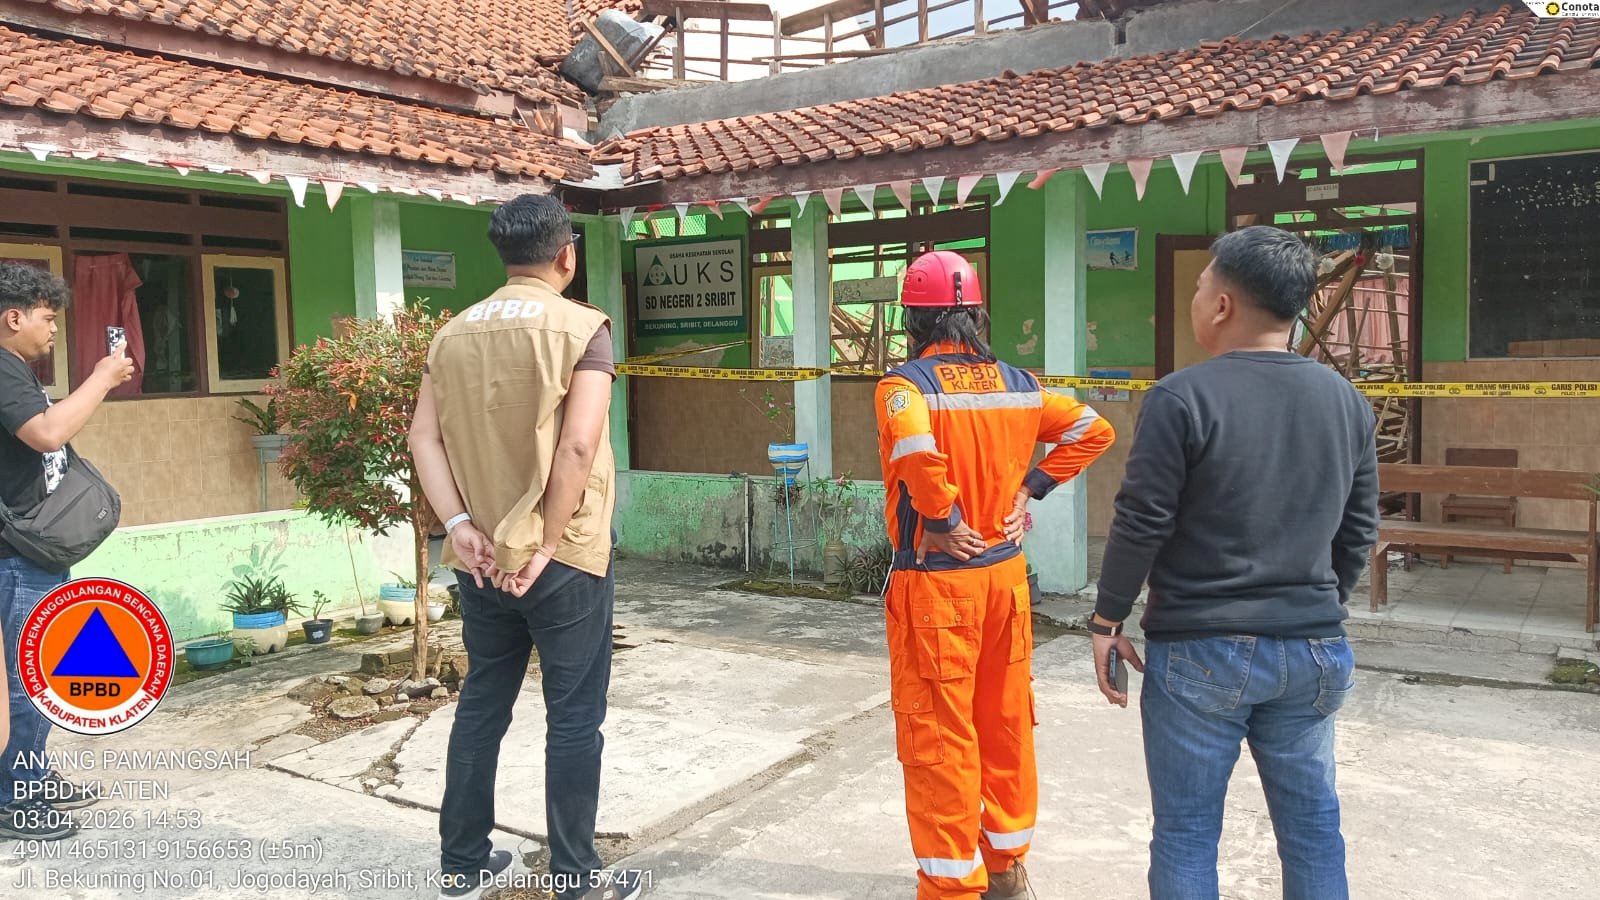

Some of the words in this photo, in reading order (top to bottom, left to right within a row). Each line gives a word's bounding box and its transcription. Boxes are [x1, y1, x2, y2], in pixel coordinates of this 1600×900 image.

[685, 250, 712, 258] KESEHATAN
[712, 248, 734, 256] SEKOLAH
[645, 295, 657, 310] SD
[659, 293, 694, 309] NEGERI
[696, 293, 702, 307] 2
[704, 291, 736, 307] SRIBIT
[465, 299, 545, 322] BPBD
[680, 321, 702, 329] SRIBIT,
[703, 319, 738, 328] DELANGGU
[941, 365, 998, 381] BPBD
[951, 380, 998, 391] KLATEN
[1498, 383, 1530, 391] MELINTAS
[1551, 383, 1572, 391] GARIS
[1574, 383, 1598, 391] POLISI
